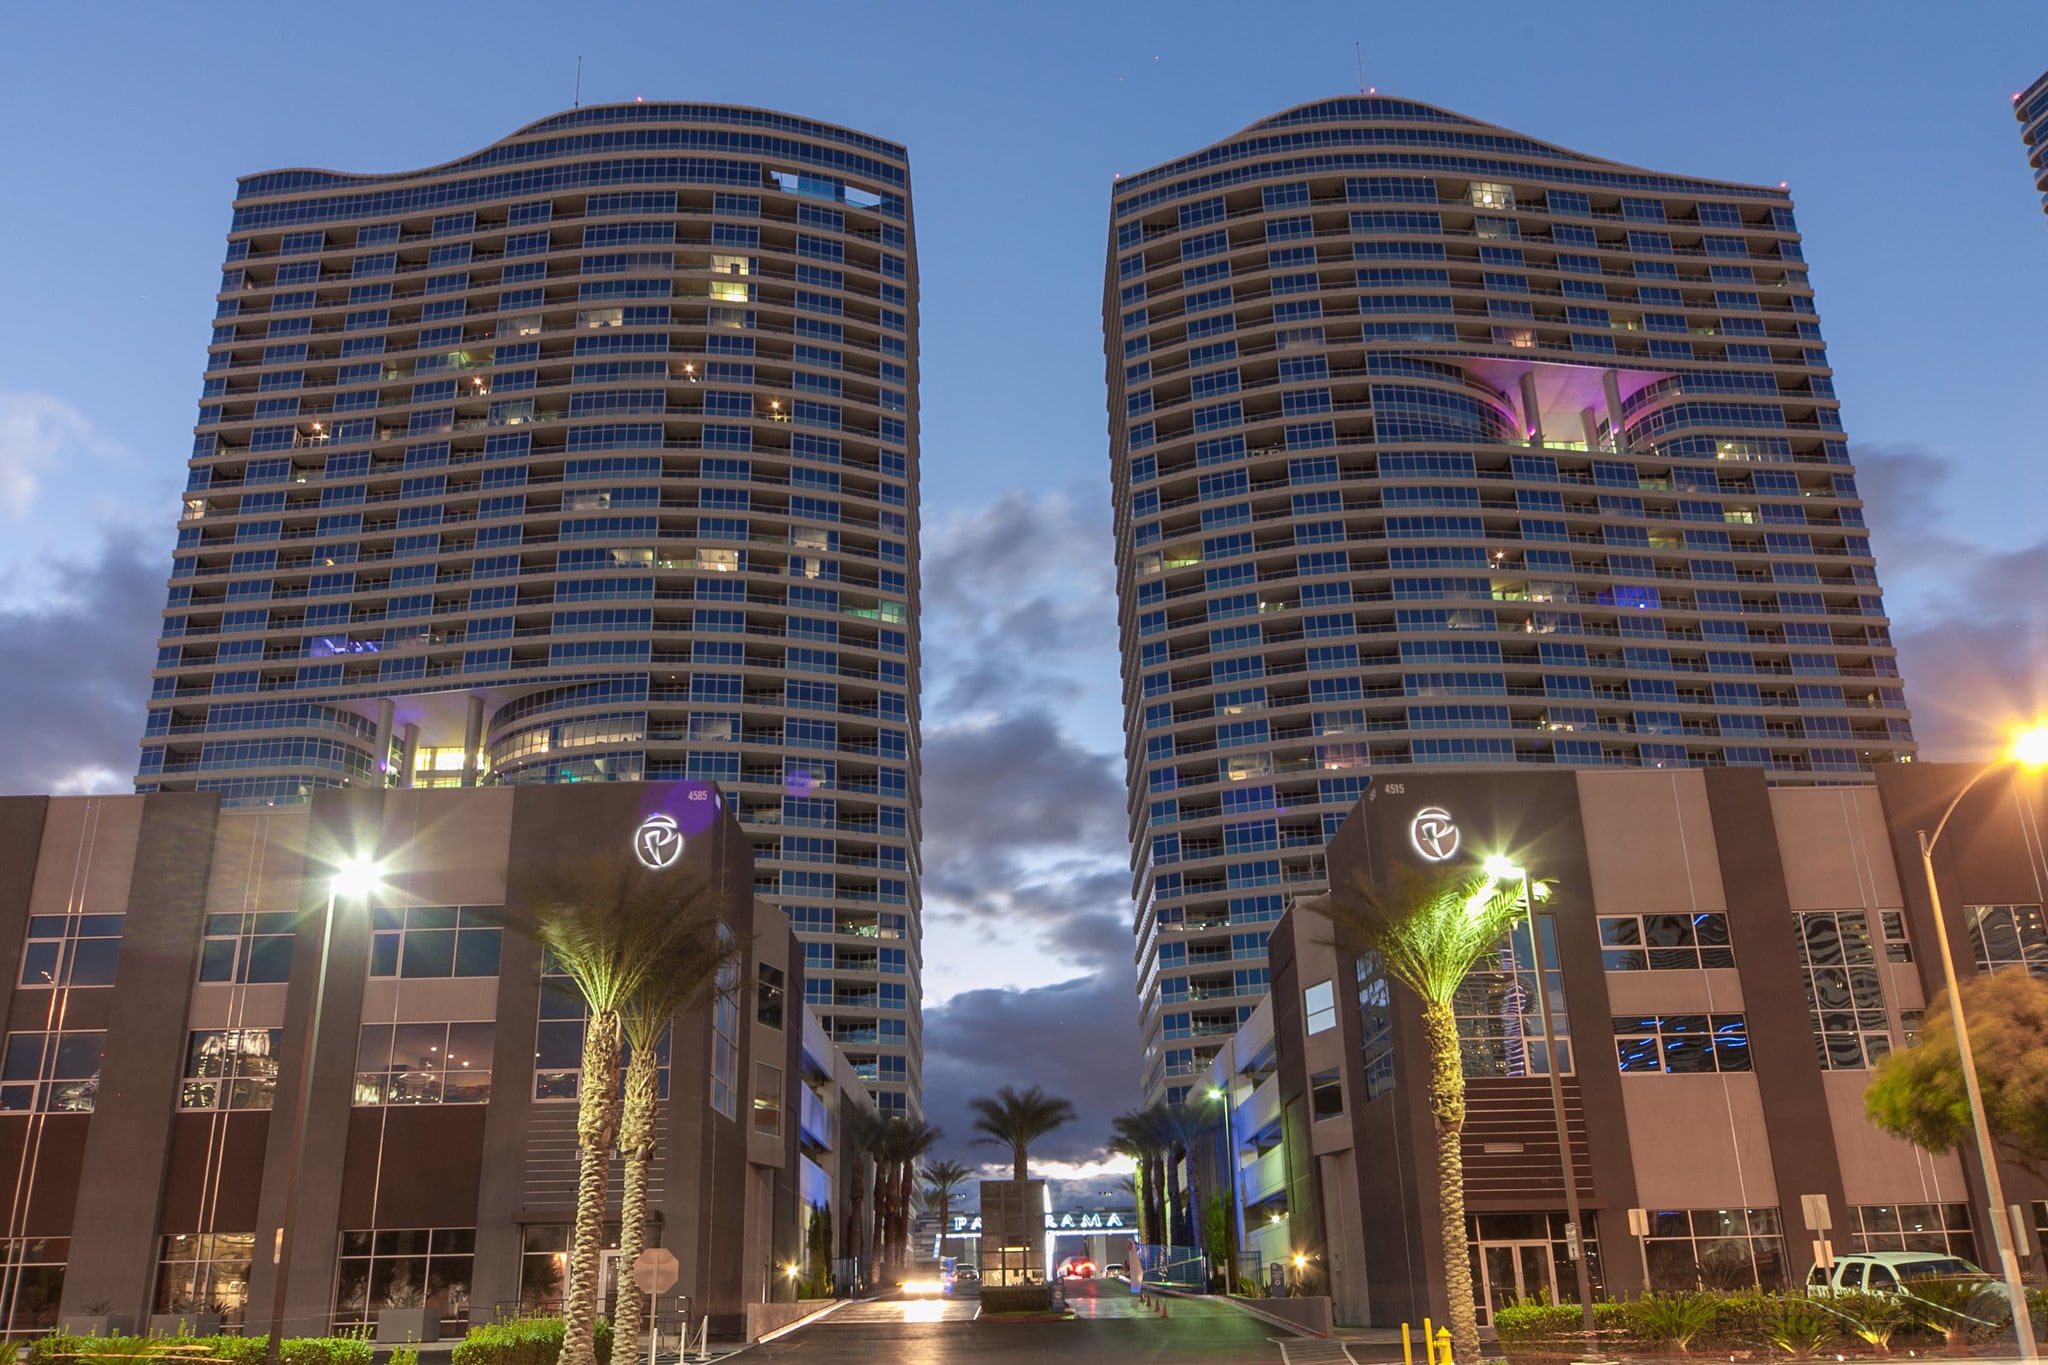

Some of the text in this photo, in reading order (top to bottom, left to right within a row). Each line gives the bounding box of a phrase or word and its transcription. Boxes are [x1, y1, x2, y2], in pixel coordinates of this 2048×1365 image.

[687, 789, 708, 802] 4585
[1384, 783, 1405, 795] 4515
[954, 1212, 1124, 1231] PARAMA
